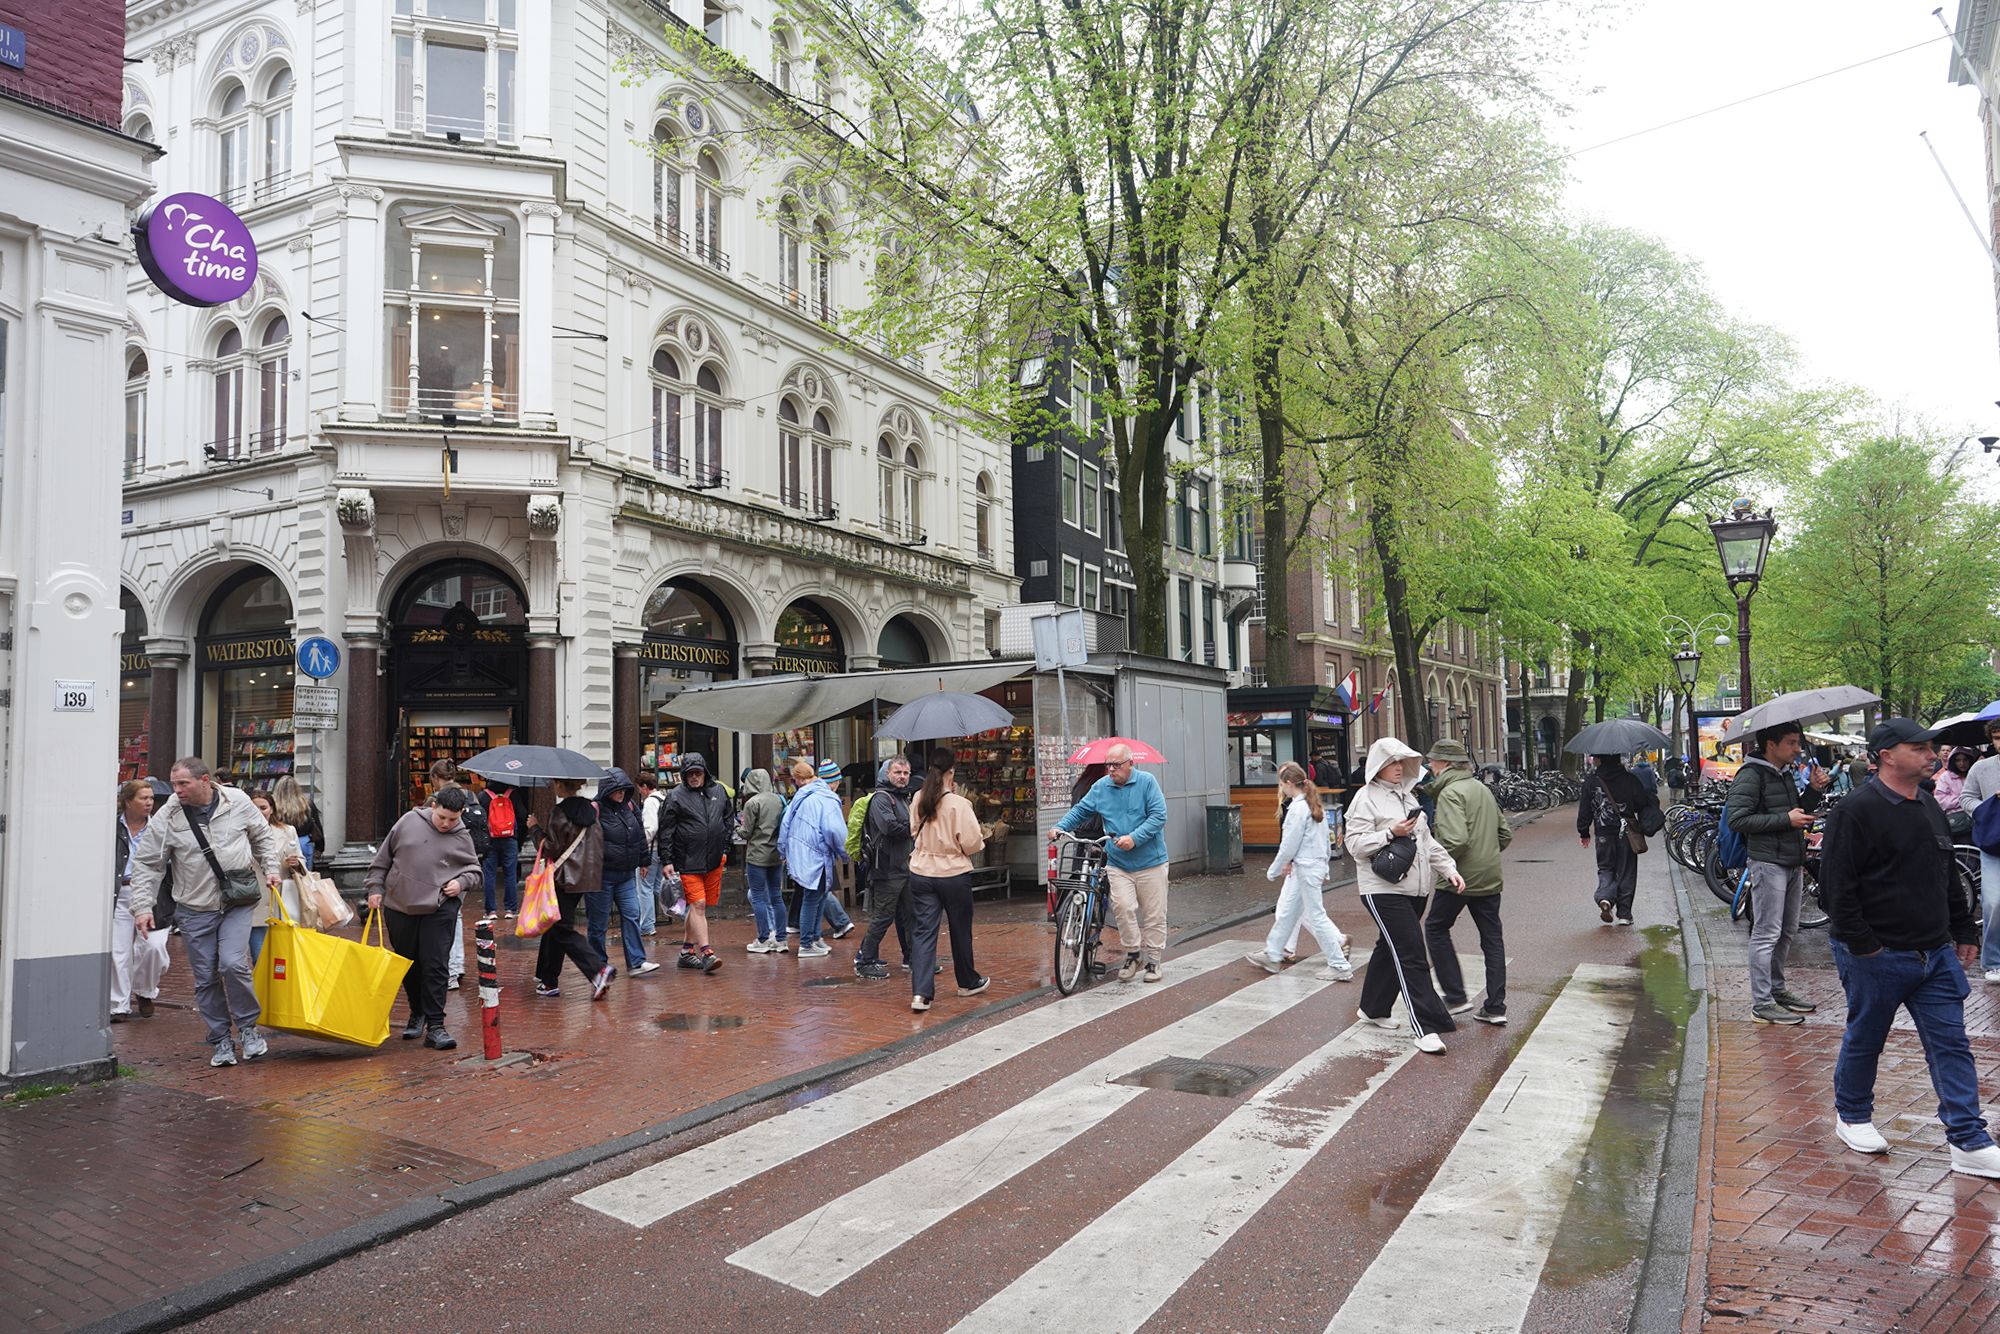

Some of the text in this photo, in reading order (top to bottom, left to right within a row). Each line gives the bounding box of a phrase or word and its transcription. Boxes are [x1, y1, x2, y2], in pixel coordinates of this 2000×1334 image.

[185, 223, 247, 262] Cha
[183, 249, 247, 281] time
[64, 691, 87, 707] 139
